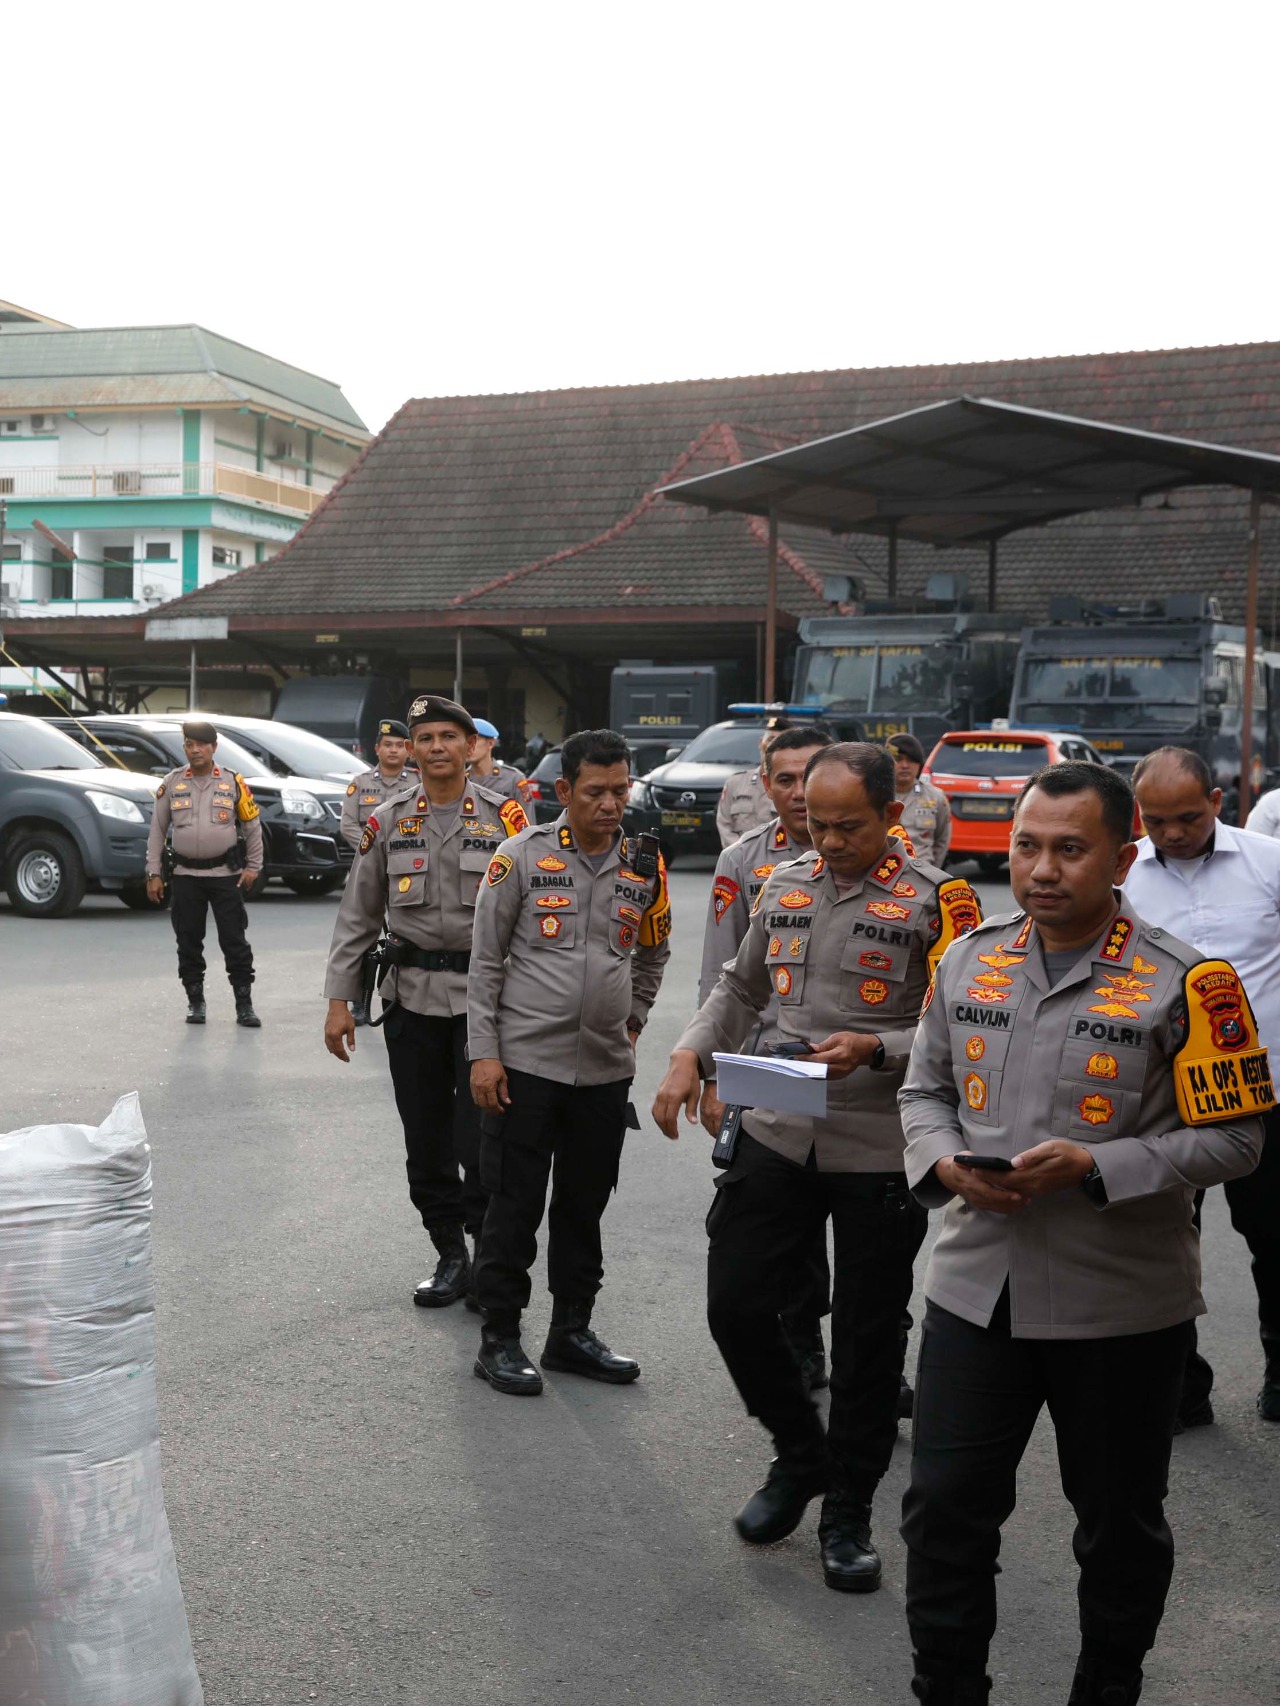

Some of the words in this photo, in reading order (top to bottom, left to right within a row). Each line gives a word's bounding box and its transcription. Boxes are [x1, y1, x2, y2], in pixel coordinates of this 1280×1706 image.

[640, 716, 681, 725] POLISI
[963, 742, 1023, 753] POLISI
[614, 884, 648, 906] POLRI
[853, 923, 910, 945] POLRI
[955, 1006, 1010, 1028] CALVIJN
[1075, 1020, 1142, 1046] POLRI
[1187, 1064, 1209, 1095] KA
[1212, 1059, 1238, 1091] OPS
[1194, 1090, 1242, 1114] LILIN
